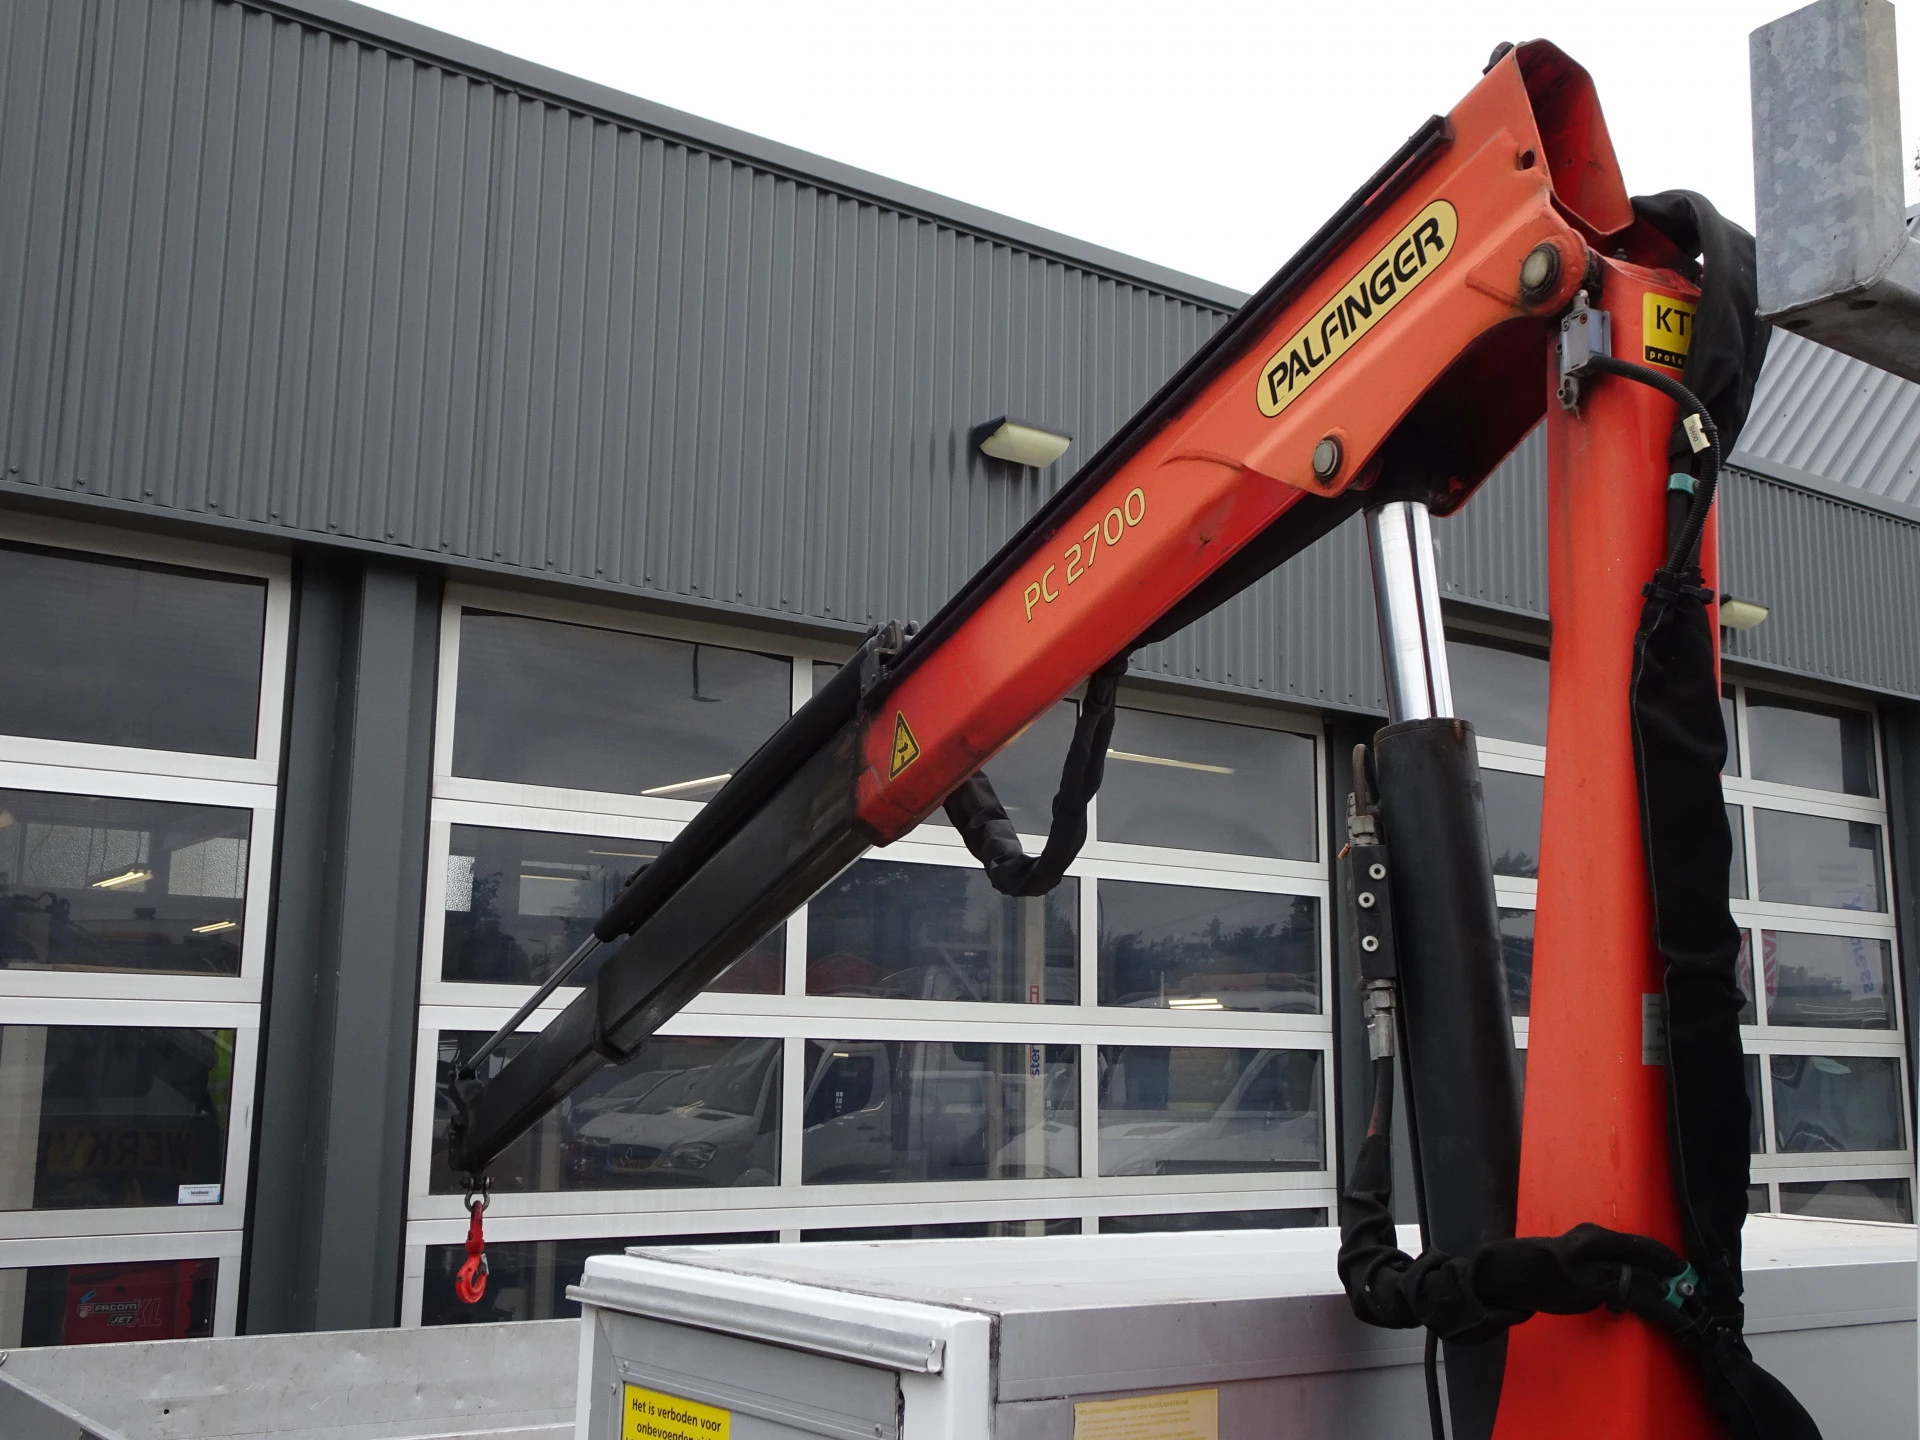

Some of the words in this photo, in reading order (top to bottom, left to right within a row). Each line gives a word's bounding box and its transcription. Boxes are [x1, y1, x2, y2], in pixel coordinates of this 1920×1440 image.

[1267, 217, 1445, 407] PALFINGER
[1656, 304, 1694, 337] KT
[1649, 351, 1683, 365] prote
[1023, 563, 1060, 623] PC
[1064, 487, 1146, 586] 2700
[1030, 1044, 1040, 1076] ster
[95, 1303, 137, 1312] FACOM
[110, 1315, 133, 1324] JET
[632, 1398, 646, 1413] Het
[648, 1401, 655, 1416] is
[657, 1407, 698, 1426] verboden
[700, 1418, 722, 1433] voor
